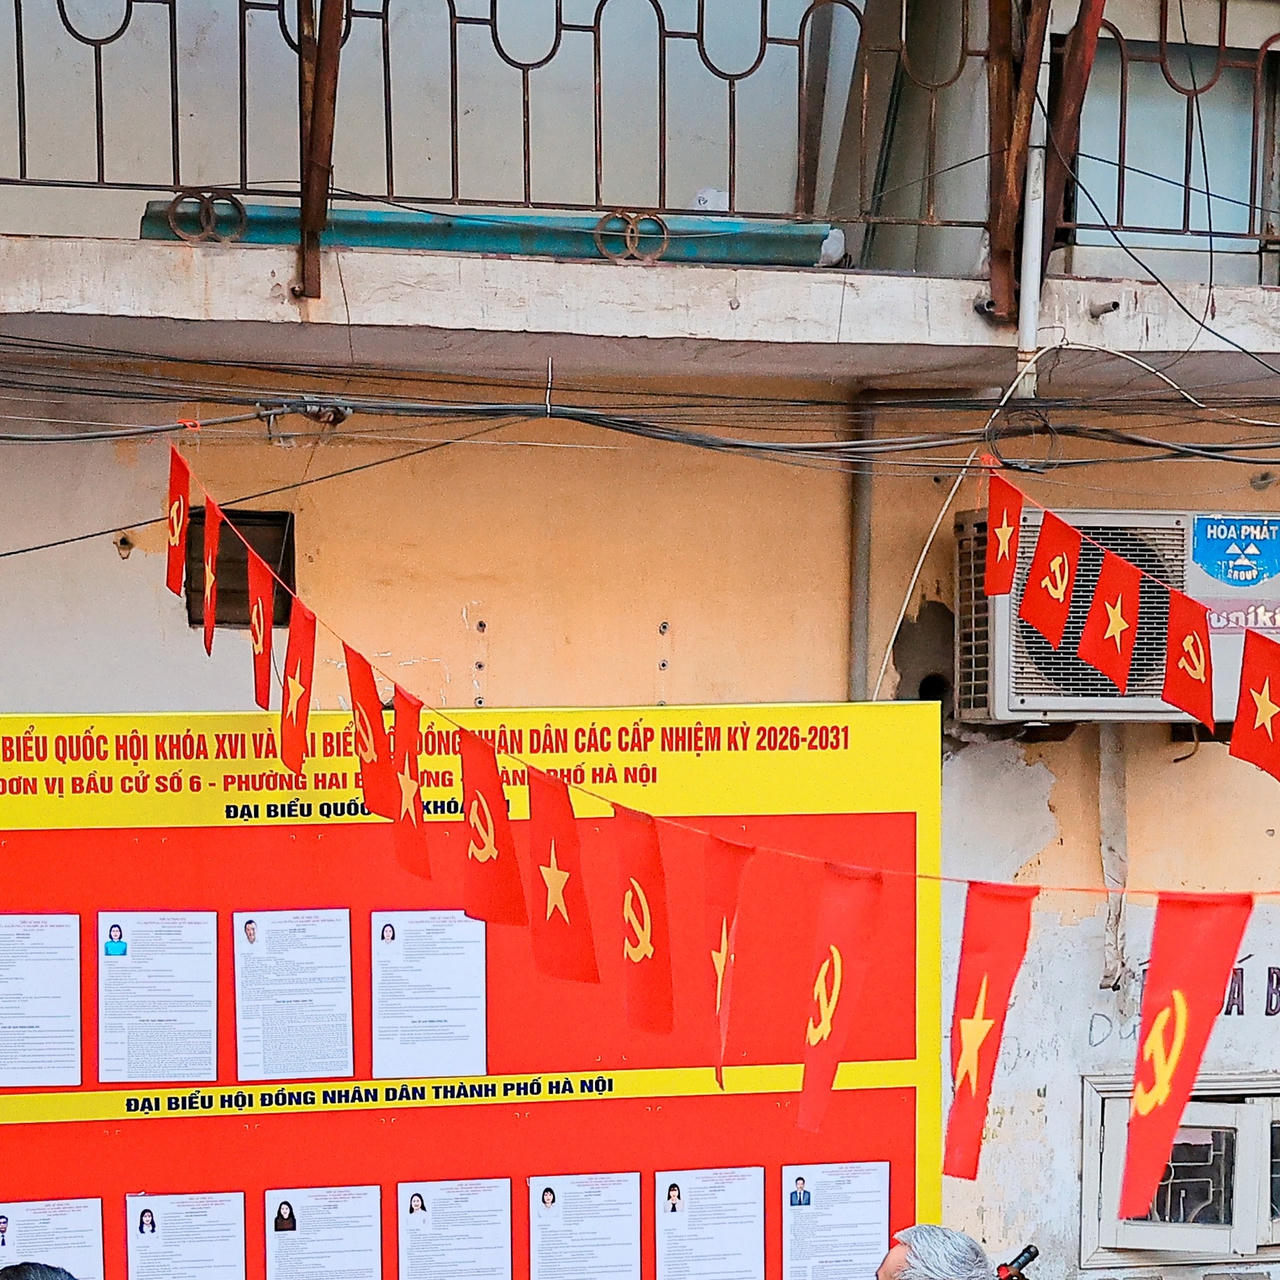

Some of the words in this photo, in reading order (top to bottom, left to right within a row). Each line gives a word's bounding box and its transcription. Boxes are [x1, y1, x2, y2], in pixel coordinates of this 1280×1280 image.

[1207, 520, 1237, 539] HÒA
[1241, 520, 1279, 540] PHÁT
[2, 725, 48, 762] BIỂU
[54, 725, 109, 765] QUỐC
[115, 729, 148, 767] HỘI
[155, 728, 208, 761] KHÓA
[214, 732, 247, 760] XVI
[248, 728, 278, 759] VÀ
[322, 720, 354, 758] BIỂ
[530, 723, 568, 754] DÂN
[575, 721, 611, 753] CÁC
[617, 717, 654, 752] CẤP
[661, 722, 721, 757] NHIỆM
[727, 721, 750, 751] KỲ
[756, 725, 849, 751] 2026-2031
[45, 777, 65, 799] VỊ
[71, 770, 113, 795] BẦU
[121, 770, 149, 794] CỬ
[155, 769, 183, 793] SỐ
[189, 774, 202, 793] 6
[223, 769, 307, 791] PHƯỜNG
[314, 772, 348, 790] HAI
[419, 768, 453, 788] ƯNG
[592, 764, 618, 784] HÀ
[624, 763, 657, 787] NỘI
[225, 804, 259, 822] ĐẠI
[266, 797, 313, 818] BIỂU
[422, 796, 464, 815] KHÓ
[126, 1097, 160, 1115] ĐẠI
[167, 1090, 213, 1110] BIỂU
[220, 1091, 254, 1110] HỘI
[260, 1088, 316, 1106] ĐỒNG
[322, 1085, 378, 1104] NHÂN
[385, 1083, 426, 1101] DÂN
[432, 1080, 496, 1099] THÀNH
[503, 1076, 542, 1096] PHỐ
[548, 1077, 574, 1094] HÀ
[580, 1075, 614, 1095] NỘI
